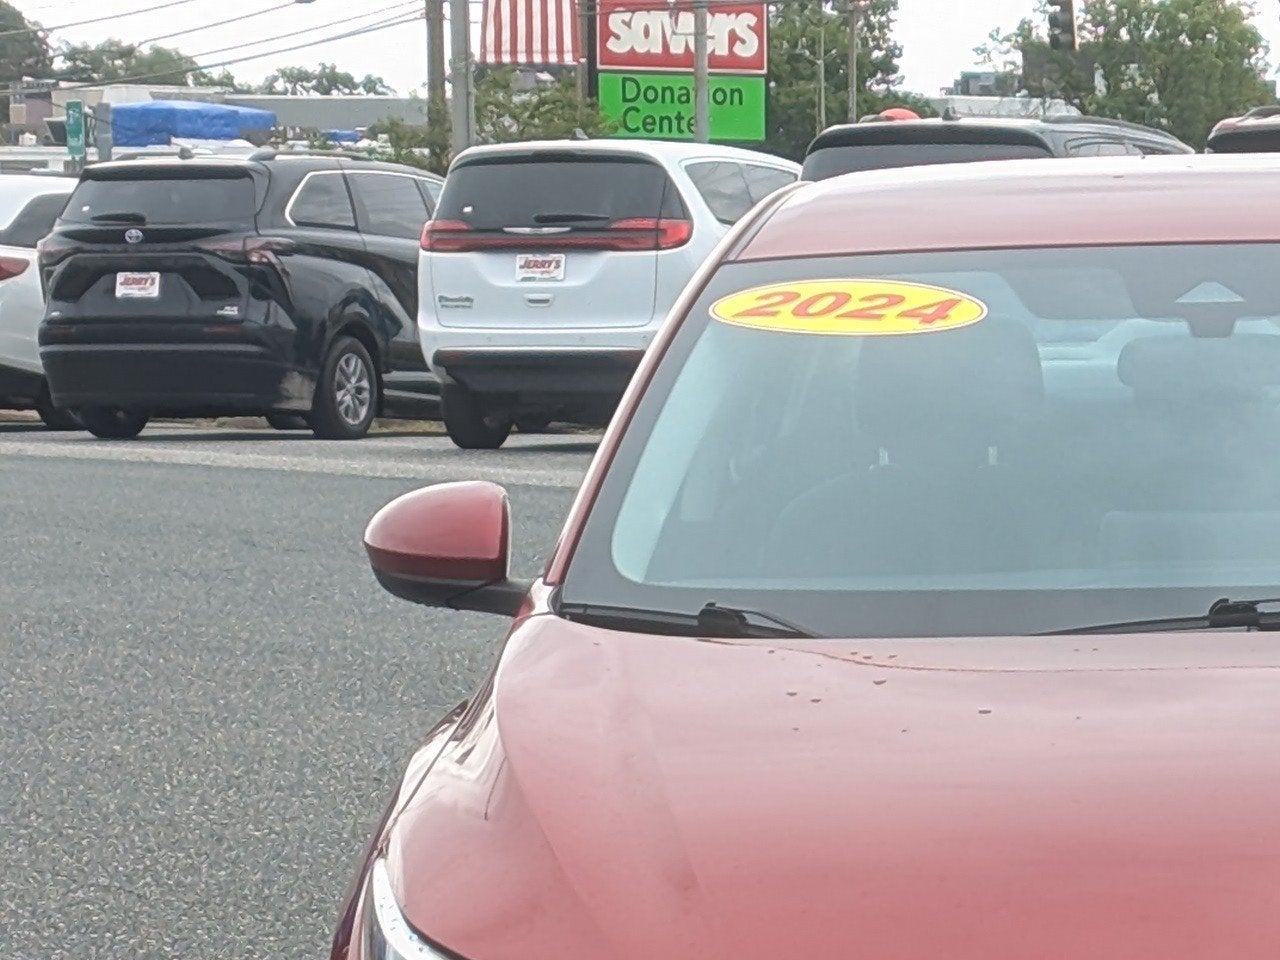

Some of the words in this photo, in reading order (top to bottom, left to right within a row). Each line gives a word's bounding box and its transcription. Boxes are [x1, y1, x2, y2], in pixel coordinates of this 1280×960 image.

[606, 10, 759, 57] savers
[621, 76, 743, 106] Donaon
[622, 106, 697, 134] Cente
[731, 291, 962, 325] 2024
